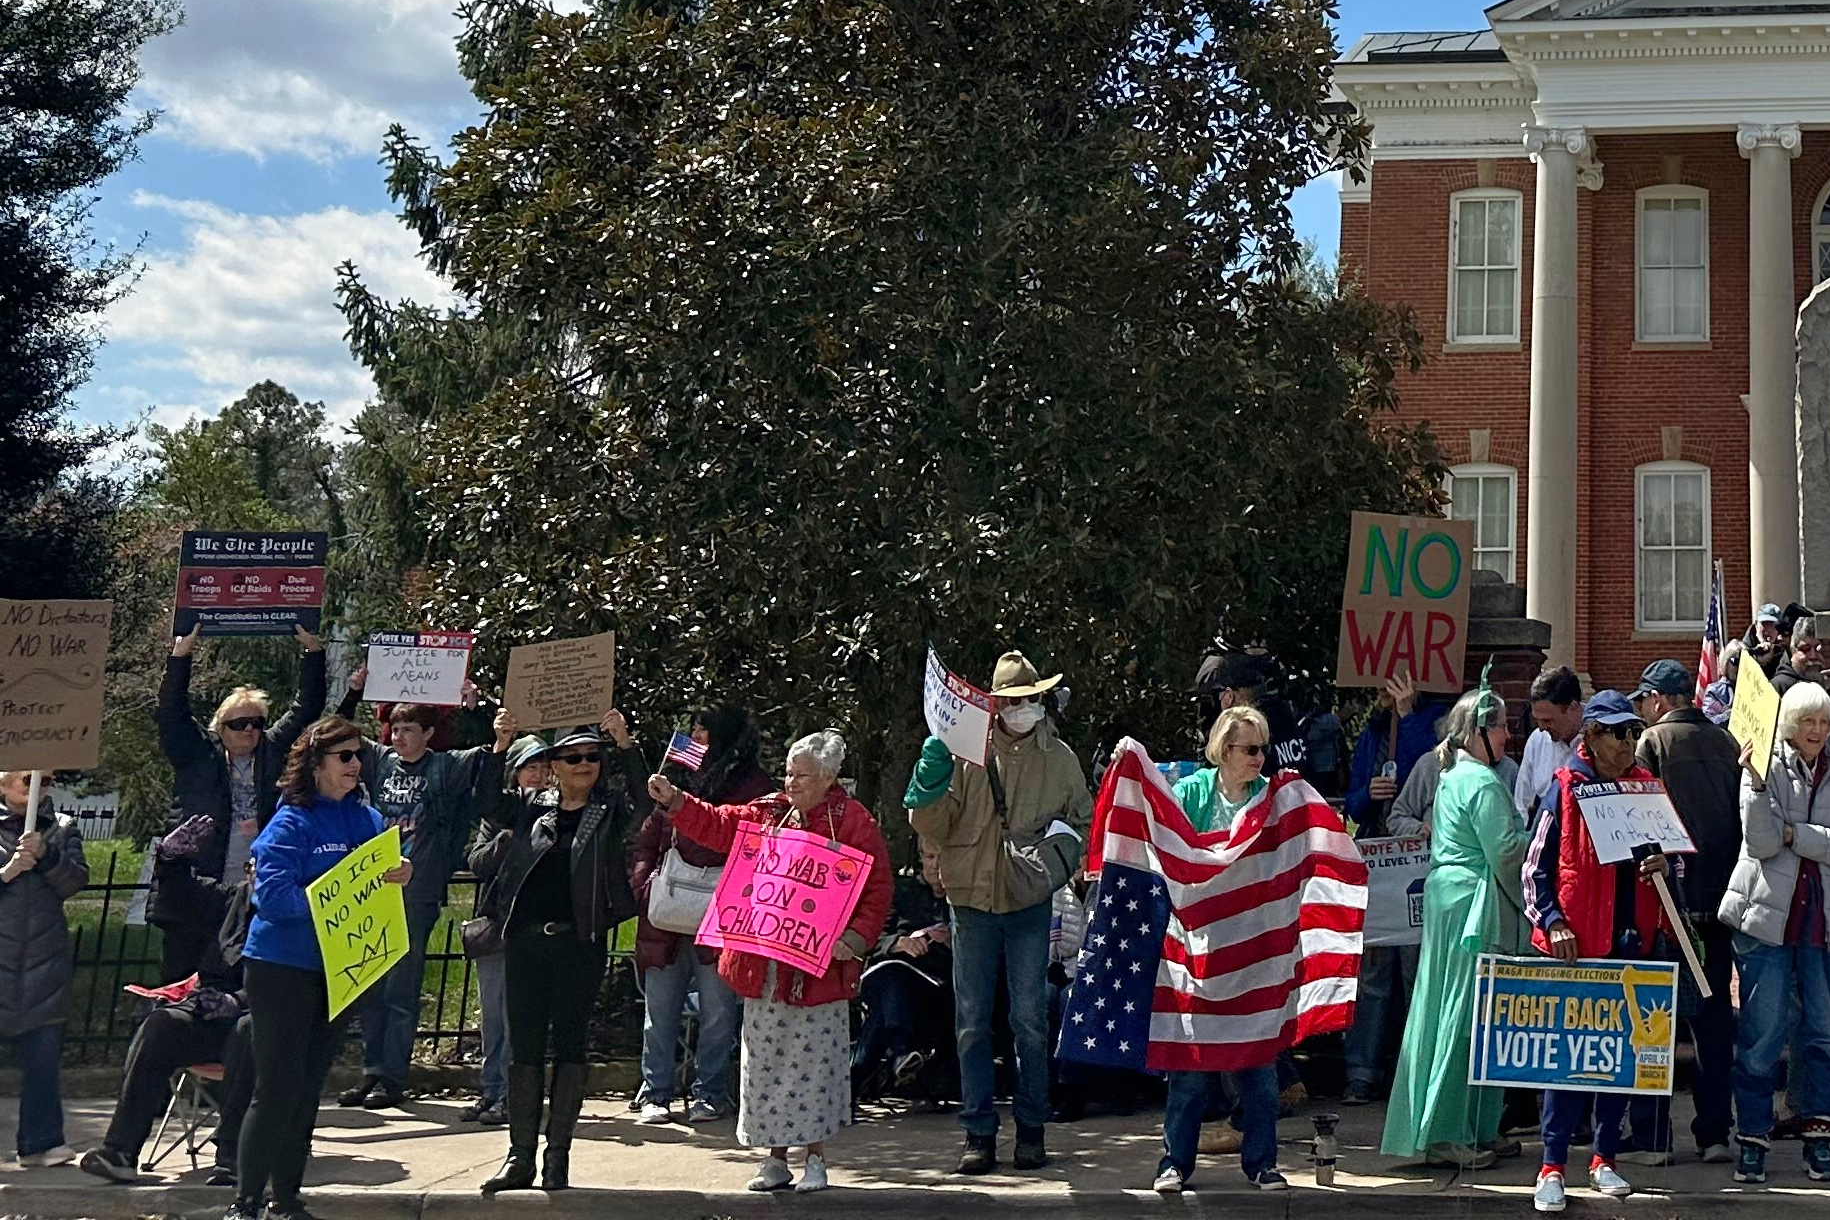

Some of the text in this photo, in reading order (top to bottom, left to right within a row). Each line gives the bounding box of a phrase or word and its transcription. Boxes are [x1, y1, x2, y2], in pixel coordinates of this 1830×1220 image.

[194, 537, 316, 554] We The People
[1359, 524, 1462, 599] NO
[2, 604, 34, 625] NO
[9, 634, 87, 657] NO WAR
[419, 635, 448, 647] STOP
[1346, 609, 1459, 688] WAR
[382, 647, 465, 659] JUSTICE FOR
[401, 658, 433, 669] ALL
[390, 669, 441, 682] MEANS
[399, 685, 430, 698] ALL
[2, 699, 65, 716] PROTECT
[1361, 839, 1422, 857] VOTE YES
[755, 851, 781, 874] NO
[1378, 857, 1411, 868] LEVEL
[318, 880, 341, 908] NO
[348, 847, 384, 884] ICE
[756, 881, 797, 909] ON
[325, 903, 350, 936] NO
[718, 905, 828, 955] CHILDREN
[346, 915, 374, 949] NO
[1497, 966, 1523, 978] MAGA
[1535, 968, 1572, 980] RIGGING
[1573, 969, 1621, 981] ELECTIONS
[1493, 993, 1625, 1032] FIGHT BACK
[1496, 1030, 1623, 1073] VOTE YES!
